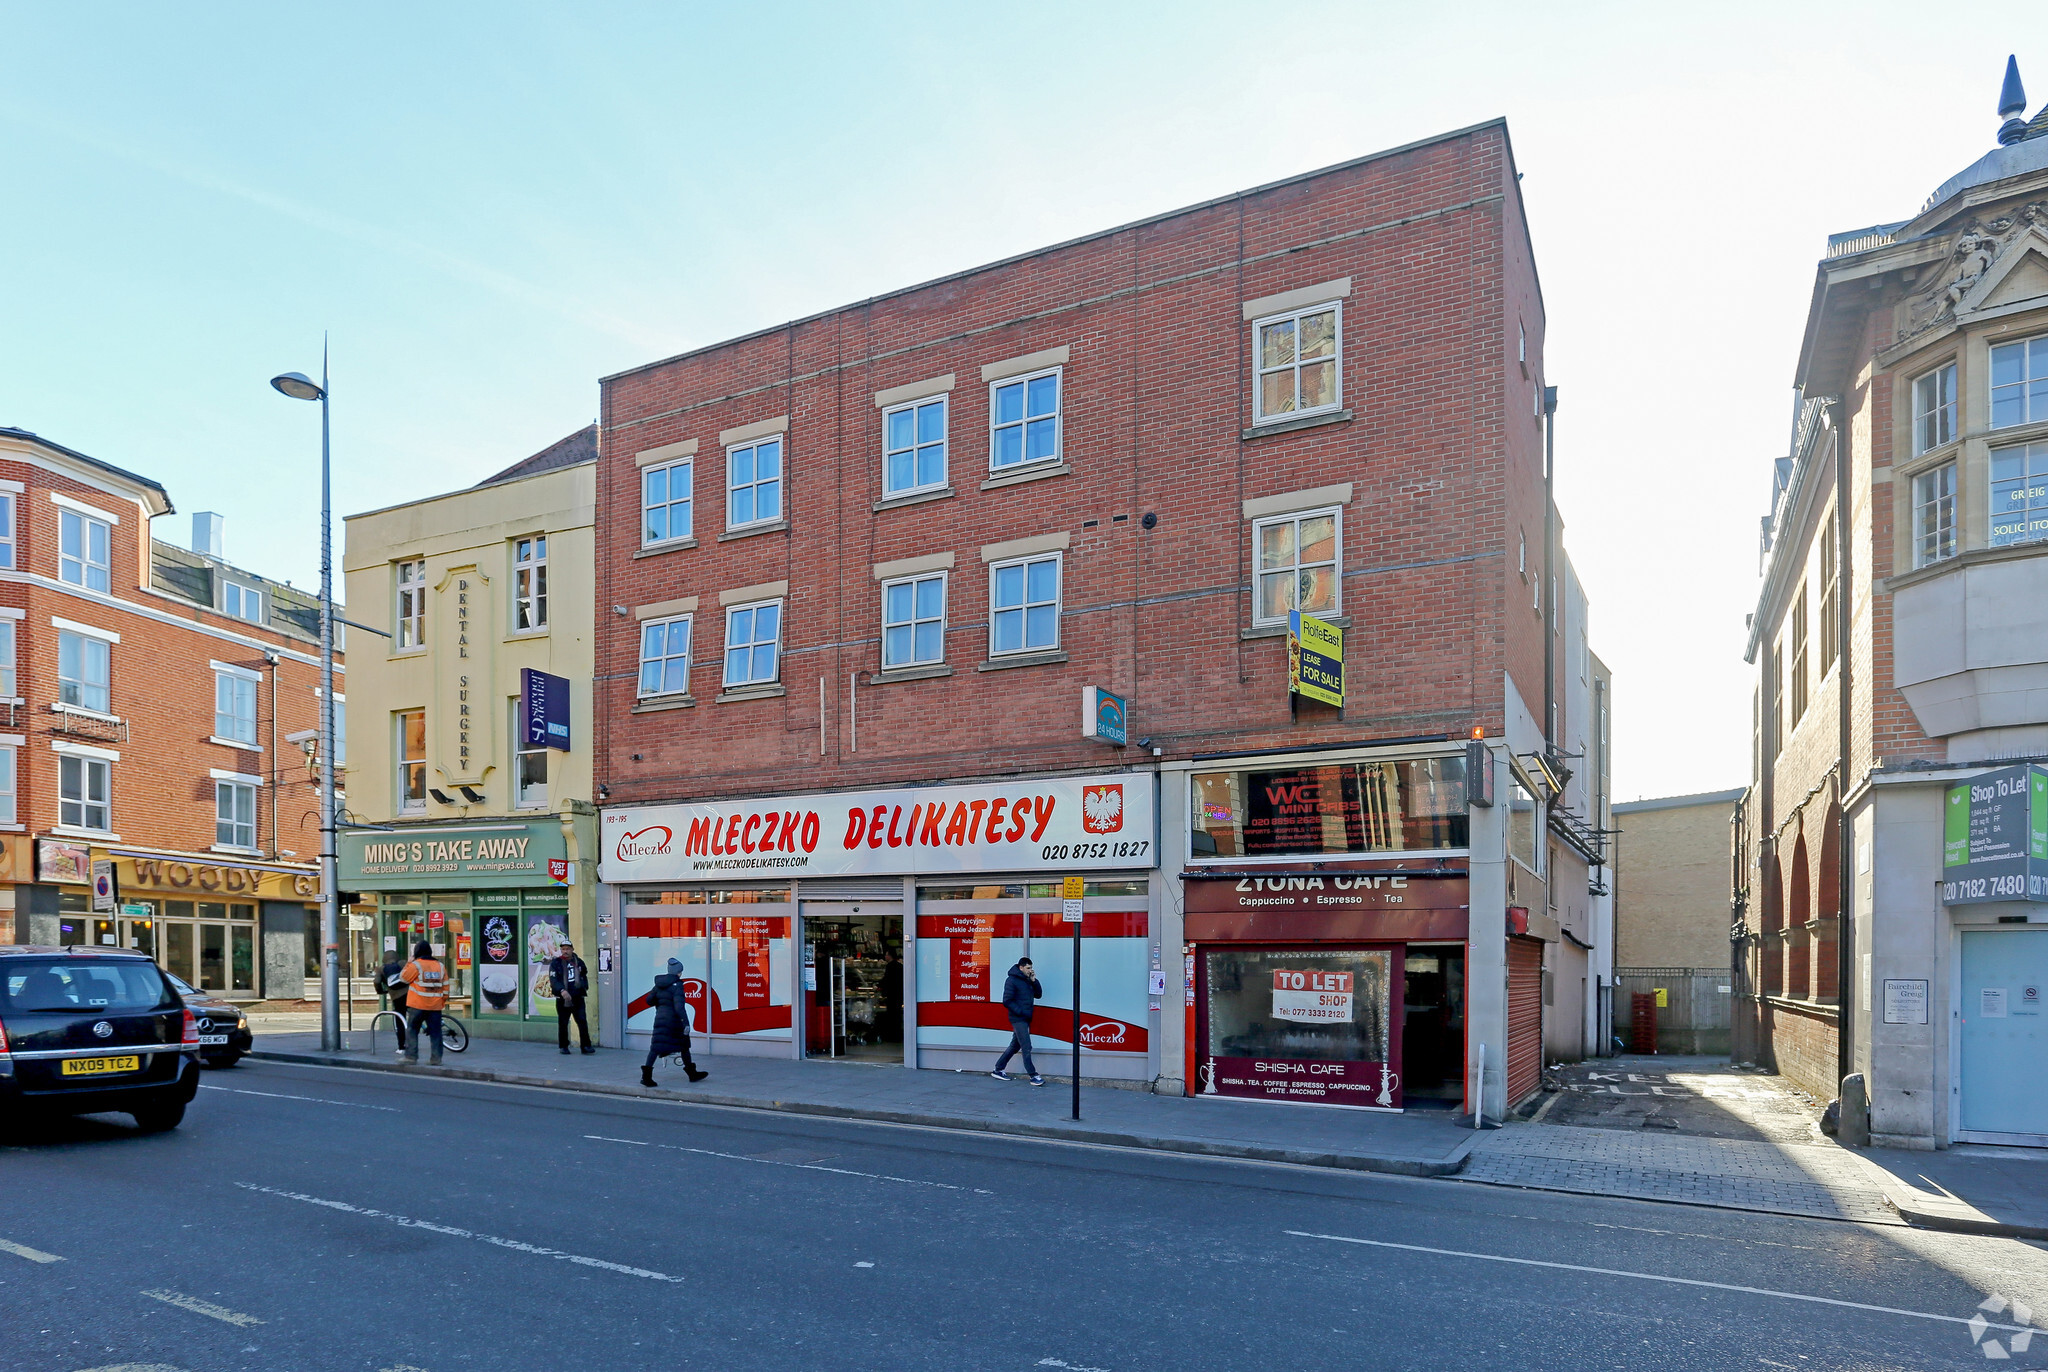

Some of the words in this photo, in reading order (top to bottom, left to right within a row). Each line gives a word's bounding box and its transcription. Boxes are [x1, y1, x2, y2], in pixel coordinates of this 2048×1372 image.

[2011, 486, 2045, 500] GREIG
[458, 580, 469, 658] DENTAL
[1303, 652, 1321, 666] LEASE
[1303, 666, 1320, 682] FOR
[1320, 671, 1340, 690] SALE
[459, 676, 470, 770] SURGERY
[549, 724, 567, 736] NHS
[1098, 722, 1106, 733] 24
[1106, 725, 1124, 742] HOURS
[1971, 785, 1994, 803] Shop
[1996, 780, 2008, 797] To
[2010, 775, 2026, 794] Let
[1204, 806, 1232, 814] OPEN
[1280, 804, 1312, 814] MINI
[1316, 801, 1360, 812] CABS
[684, 810, 820, 857] MLECZKO
[843, 794, 1056, 850] DELIKATESY
[365, 842, 422, 864] MING'S
[426, 840, 472, 861] TAKE
[476, 838, 529, 859] AWAY
[621, 842, 671, 857] Mleczko
[1042, 845, 1068, 860] 020
[1072, 842, 1108, 859] 8752
[1112, 841, 1149, 858] 1827
[381, 865, 409, 874] DELIVERY
[413, 865, 424, 873] 020
[426, 864, 440, 872] 8992
[442, 863, 458, 871] 3929
[467, 861, 534, 872] www.mingsw3.co.uk
[693, 856, 808, 870] WWW.MLECZKODELIKATESY.COM
[134, 858, 263, 892] WOODY
[1959, 879, 1986, 899] 7182
[1990, 874, 2024, 896] 7480
[2030, 875, 2040, 895] 020
[1239, 896, 1295, 906] Cappuccino
[1317, 895, 1362, 904] Espresso
[1384, 895, 1403, 903] Tea
[1280, 973, 1305, 989] TO
[1312, 974, 1347, 990] LET
[684, 990, 702, 998] czko
[1319, 995, 1347, 1006] SHOP
[1308, 1009, 1326, 1017] 3333
[1080, 1032, 1125, 1044] Mleczko
[69, 1060, 105, 1072] NX09
[108, 1058, 133, 1069] TCZ
[1255, 1062, 1305, 1074] SHISHA
[1310, 1064, 1344, 1076] CAFE
[1328, 1083, 1370, 1091] CAPPUCCINO
